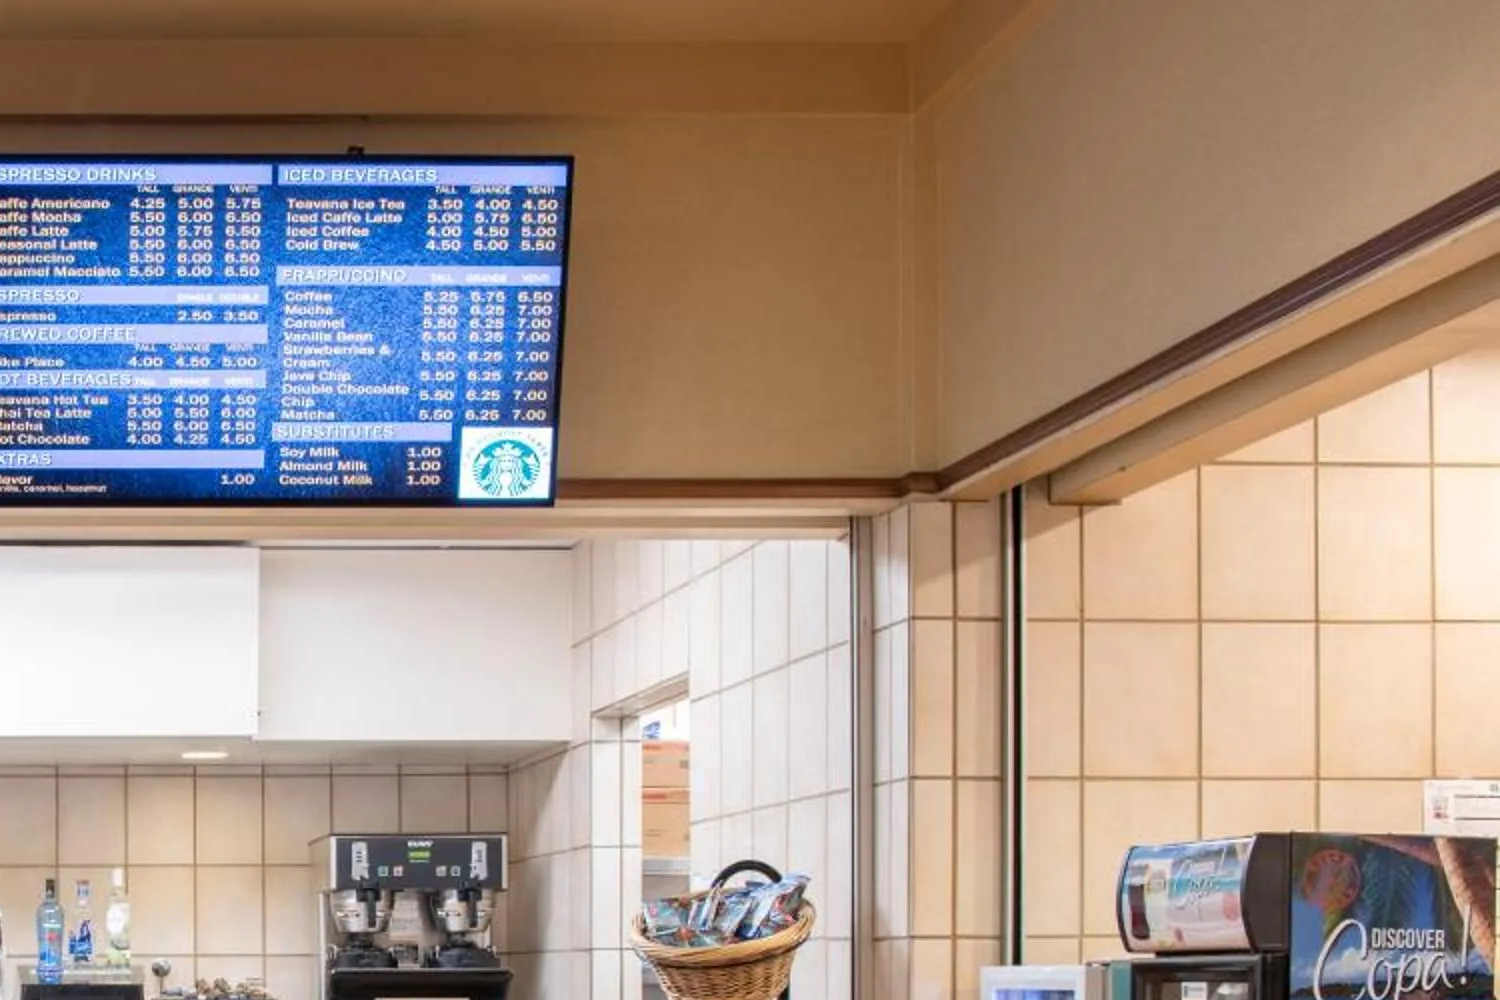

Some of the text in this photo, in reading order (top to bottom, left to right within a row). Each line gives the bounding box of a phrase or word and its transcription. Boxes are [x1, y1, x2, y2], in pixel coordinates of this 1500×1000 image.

[87, 167, 156, 181] DRINKS
[285, 169, 437, 182] ICED BEVERAGES
[31, 198, 111, 209] Americano
[129, 198, 165, 209] 4.25
[177, 198, 213, 209] 5.00
[353, 198, 375, 210] Ice
[379, 198, 405, 210] Tea
[428, 198, 463, 210] 3.50
[475, 198, 510, 210] 4.00
[31, 211, 82, 223] Mocha
[129, 211, 165, 223] 5.50
[177, 211, 213, 223] 6.00
[225, 211, 261, 223] 6.50
[287, 212, 318, 224] Iced
[322, 212, 361, 224] Caffe
[365, 212, 402, 224] Latte
[427, 212, 463, 224] 5.00
[31, 225, 69, 237] Latte
[129, 225, 165, 237] 5.00
[177, 225, 213, 237] 5.75
[225, 225, 261, 237] 6.50
[286, 225, 317, 237] Iced
[322, 225, 370, 237] Coffee
[426, 225, 462, 237] 4.00
[474, 225, 509, 237] 4.50
[60, 239, 98, 250] Latte
[286, 239, 509, 251] Cold Brew 4.50 5.00
[177, 253, 213, 264] 6.00
[283, 269, 406, 282] FRAPPUCCINO
[285, 291, 553, 302] Coffee 6.50
[518, 305, 552, 315] 7.00
[284, 318, 551, 329] Caramel 7.00
[68, 327, 136, 341] COFFEE
[516, 332, 550, 342] 7.00
[515, 351, 549, 362] 7.00
[128, 357, 163, 368] 4.00
[27, 373, 132, 386] BEVERAGES
[513, 371, 548, 381] 7.00
[337, 384, 410, 395] Chocolate
[53, 395, 256, 405] Hot Tea 4.00 4.50
[513, 390, 547, 401] 7.00
[26, 408, 51, 419] Tea
[56, 408, 92, 419] Latte
[127, 408, 162, 419] 5.00
[174, 408, 209, 419] 5.50
[281, 409, 547, 420] Matcha 7.00
[174, 421, 209, 432] 6.00
[221, 421, 256, 432] 6.50
[276, 425, 393, 439] SUBSTITUTES
[18, 434, 90, 445] Chocolate
[127, 434, 162, 445] 4.00
[174, 434, 209, 445] 4.25
[279, 447, 442, 459] Soy Milk 1.00
[279, 461, 441, 471] Almond Milk 1.00
[221, 474, 255, 485] 1.00
[279, 475, 441, 486] Coconut Milk 1.00
[1371, 927, 1446, 950] DISCOVER
